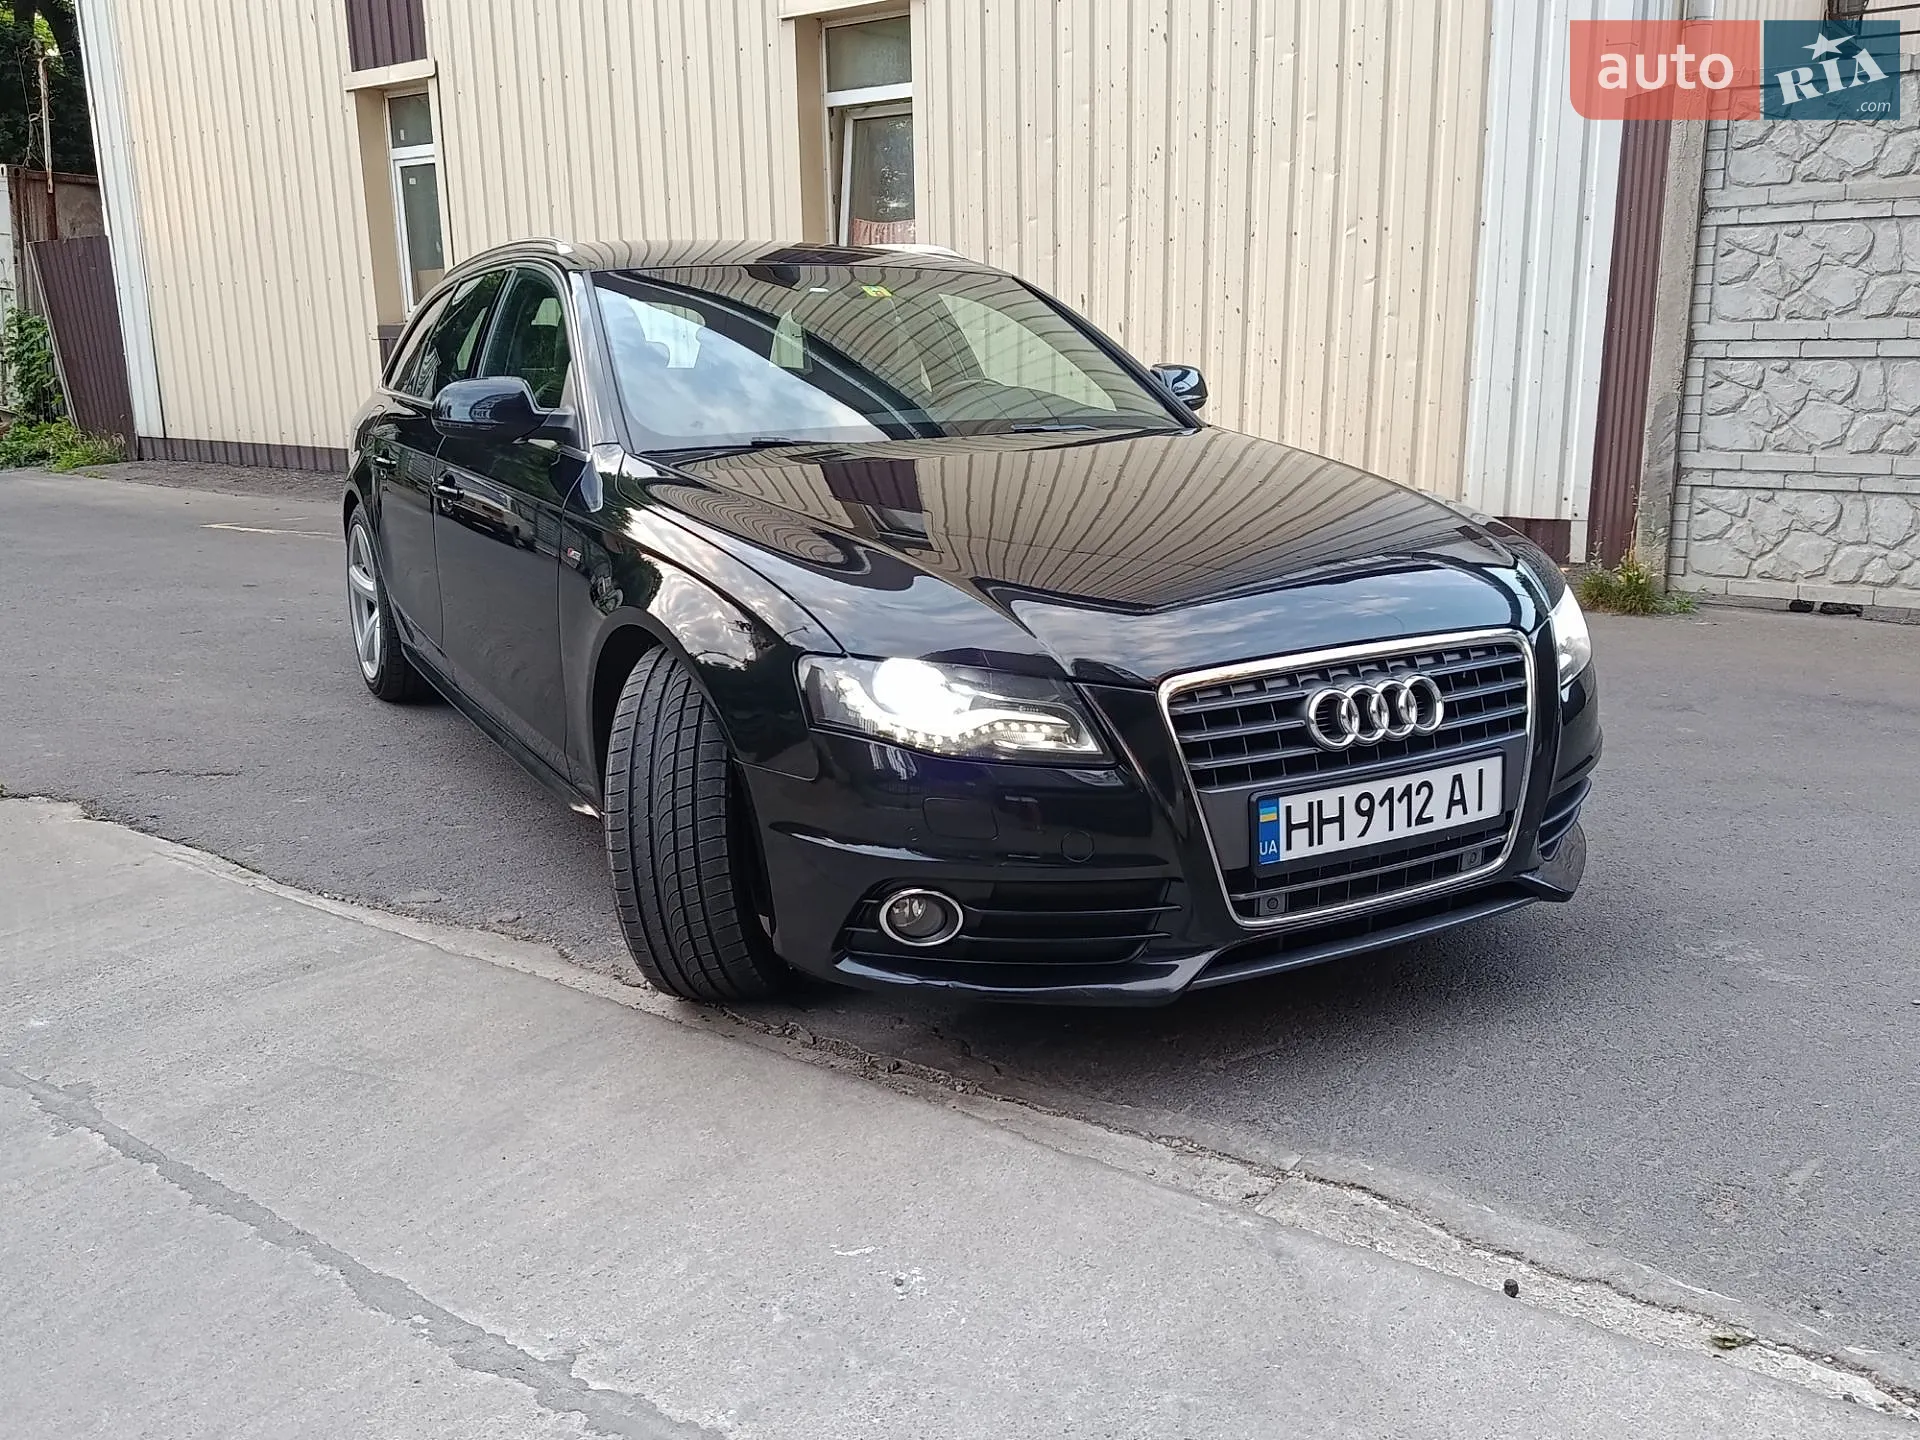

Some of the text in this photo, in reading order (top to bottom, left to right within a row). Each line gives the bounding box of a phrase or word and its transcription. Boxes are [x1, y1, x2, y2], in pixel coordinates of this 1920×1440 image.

[1285, 768, 1484, 851] HH 9112 AI
[1259, 841, 1278, 856] UA
